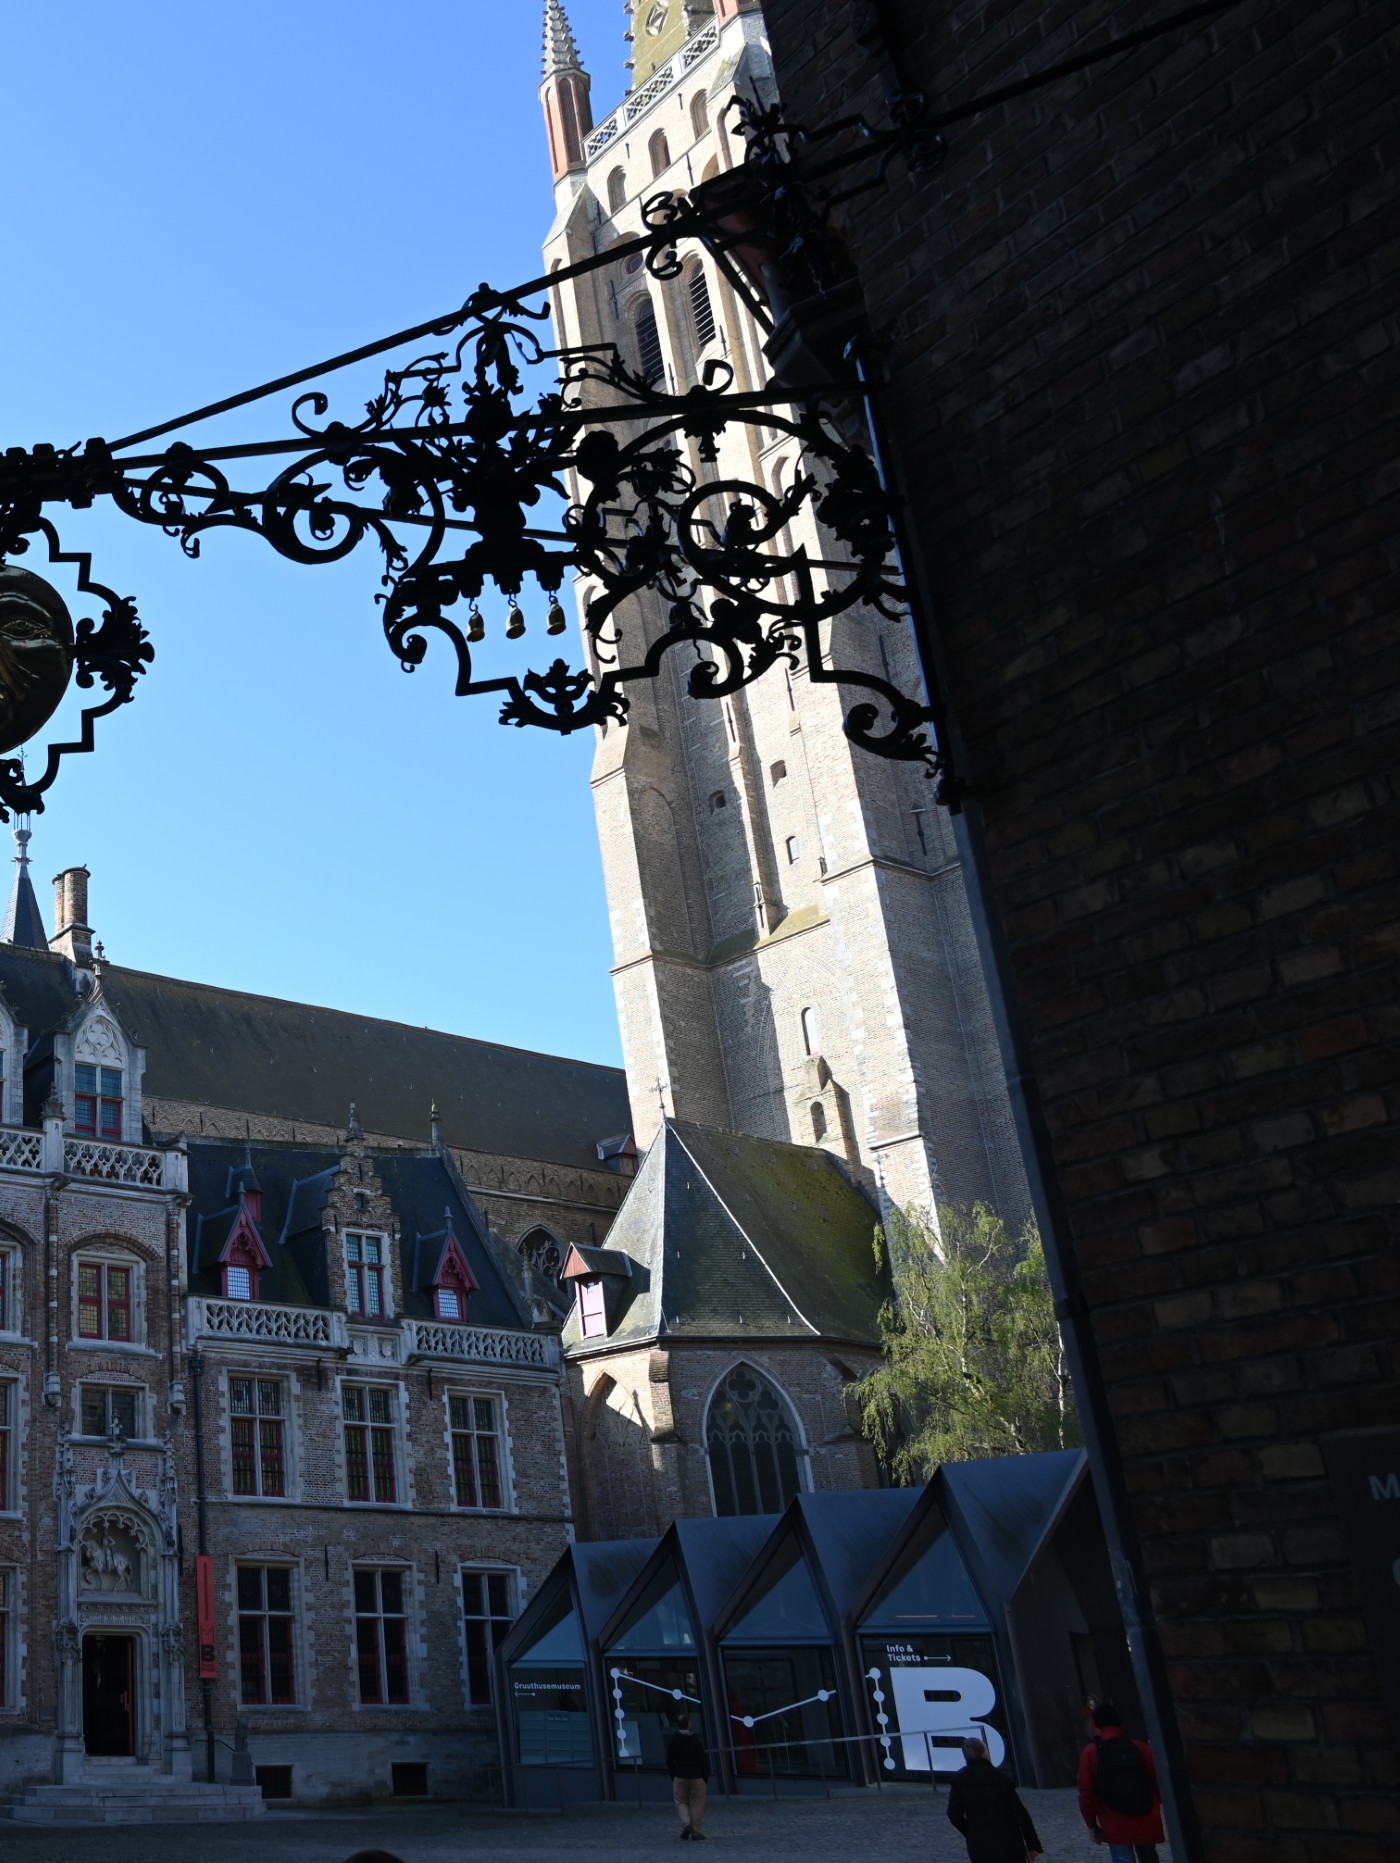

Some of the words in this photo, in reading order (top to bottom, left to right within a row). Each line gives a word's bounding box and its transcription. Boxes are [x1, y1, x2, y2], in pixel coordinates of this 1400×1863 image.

[202, 1644, 215, 1662] B
[887, 1653, 921, 1661] Tickets
[514, 1682, 581, 1690] Gruuthusemuseum
[890, 1667, 1005, 1771] B
